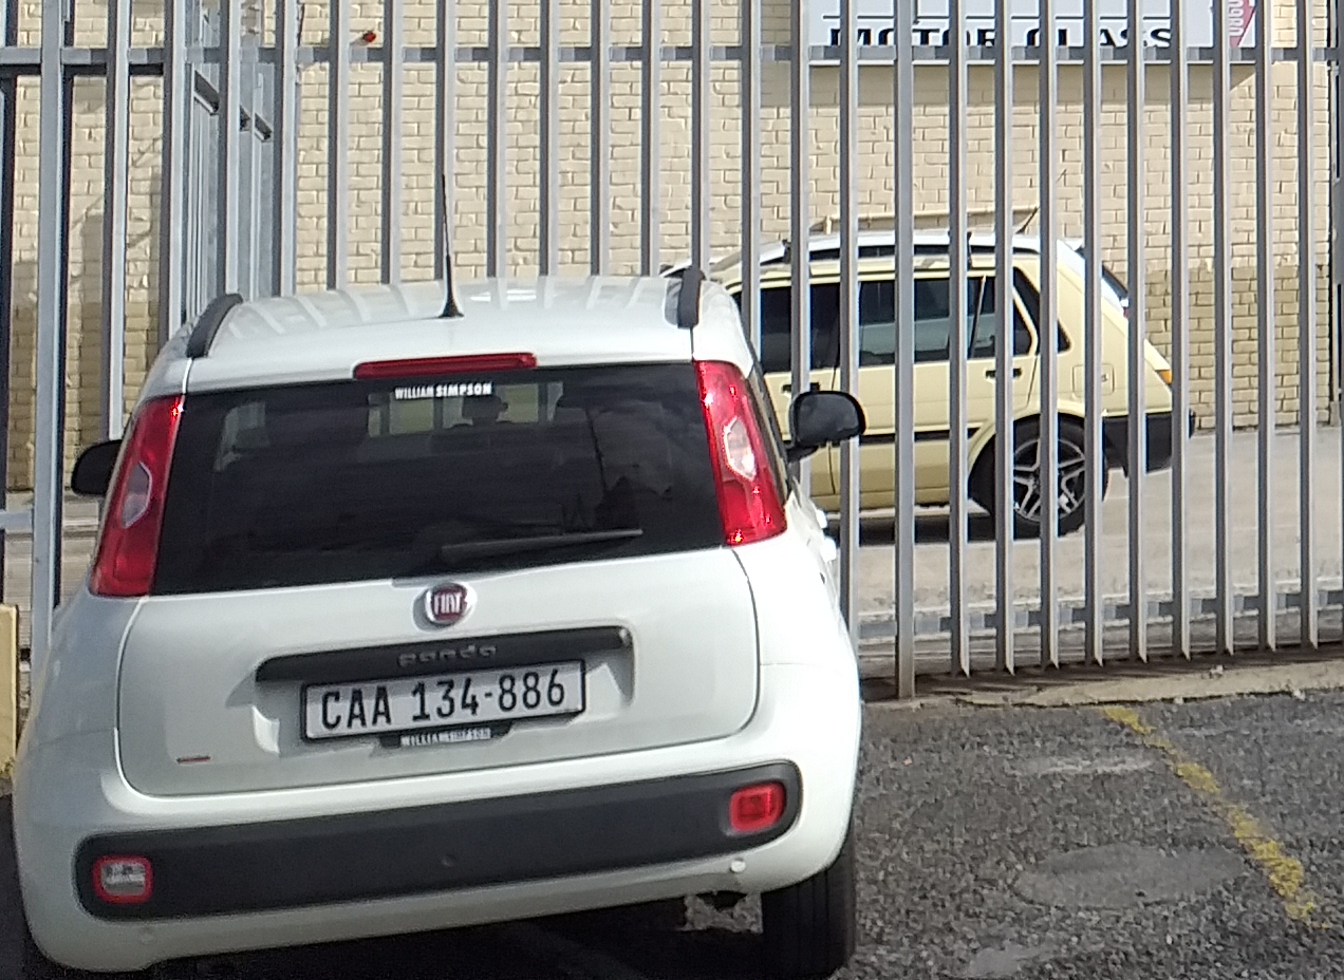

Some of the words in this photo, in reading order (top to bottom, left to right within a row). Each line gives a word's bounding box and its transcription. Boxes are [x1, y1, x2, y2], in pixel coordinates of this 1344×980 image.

[395, 385, 434, 400] WILLIAM
[436, 381, 492, 398] SIMPSON
[434, 592, 462, 615] FIAT
[321, 685, 392, 730] CAA
[411, 668, 566, 722] 134-886
